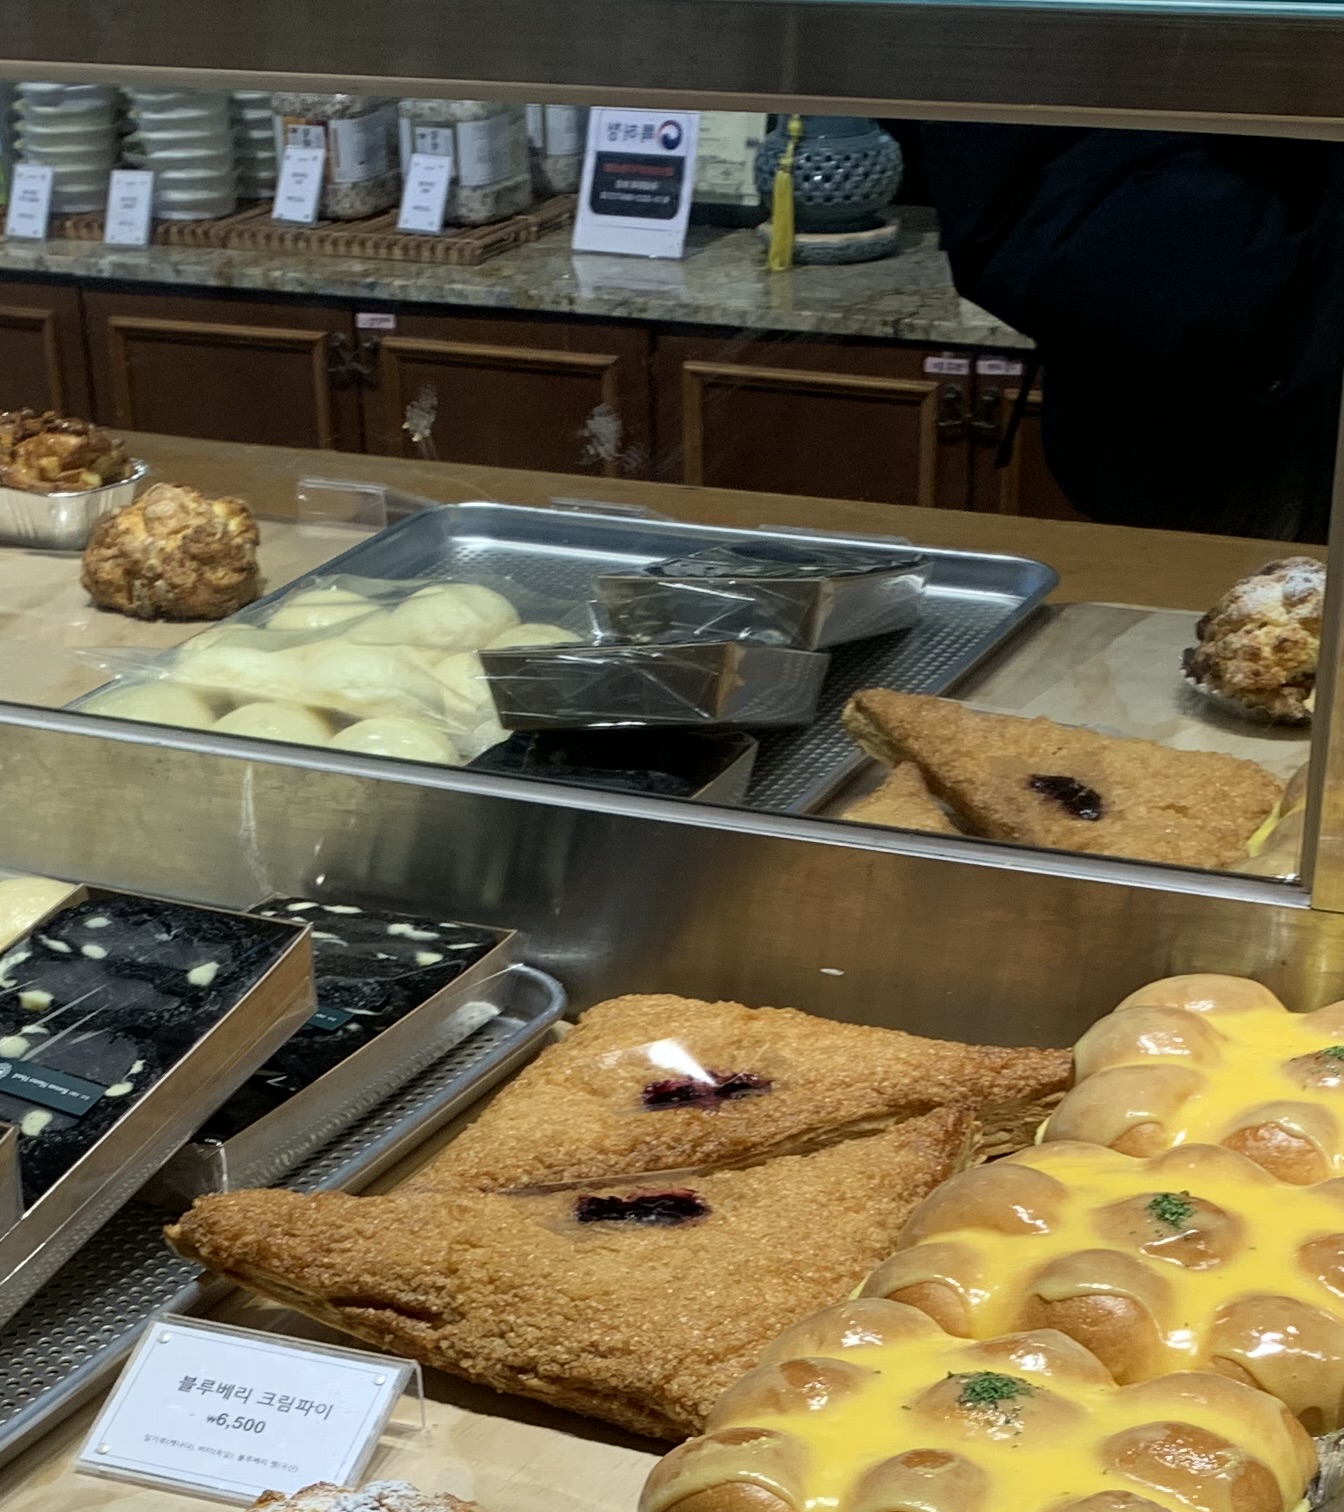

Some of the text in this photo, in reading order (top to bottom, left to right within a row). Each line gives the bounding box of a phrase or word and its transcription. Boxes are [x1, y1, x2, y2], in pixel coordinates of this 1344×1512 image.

[178, 1375, 334, 1421] 블루베리 크림파이
[206, 1413, 266, 1433] ₩6,500
